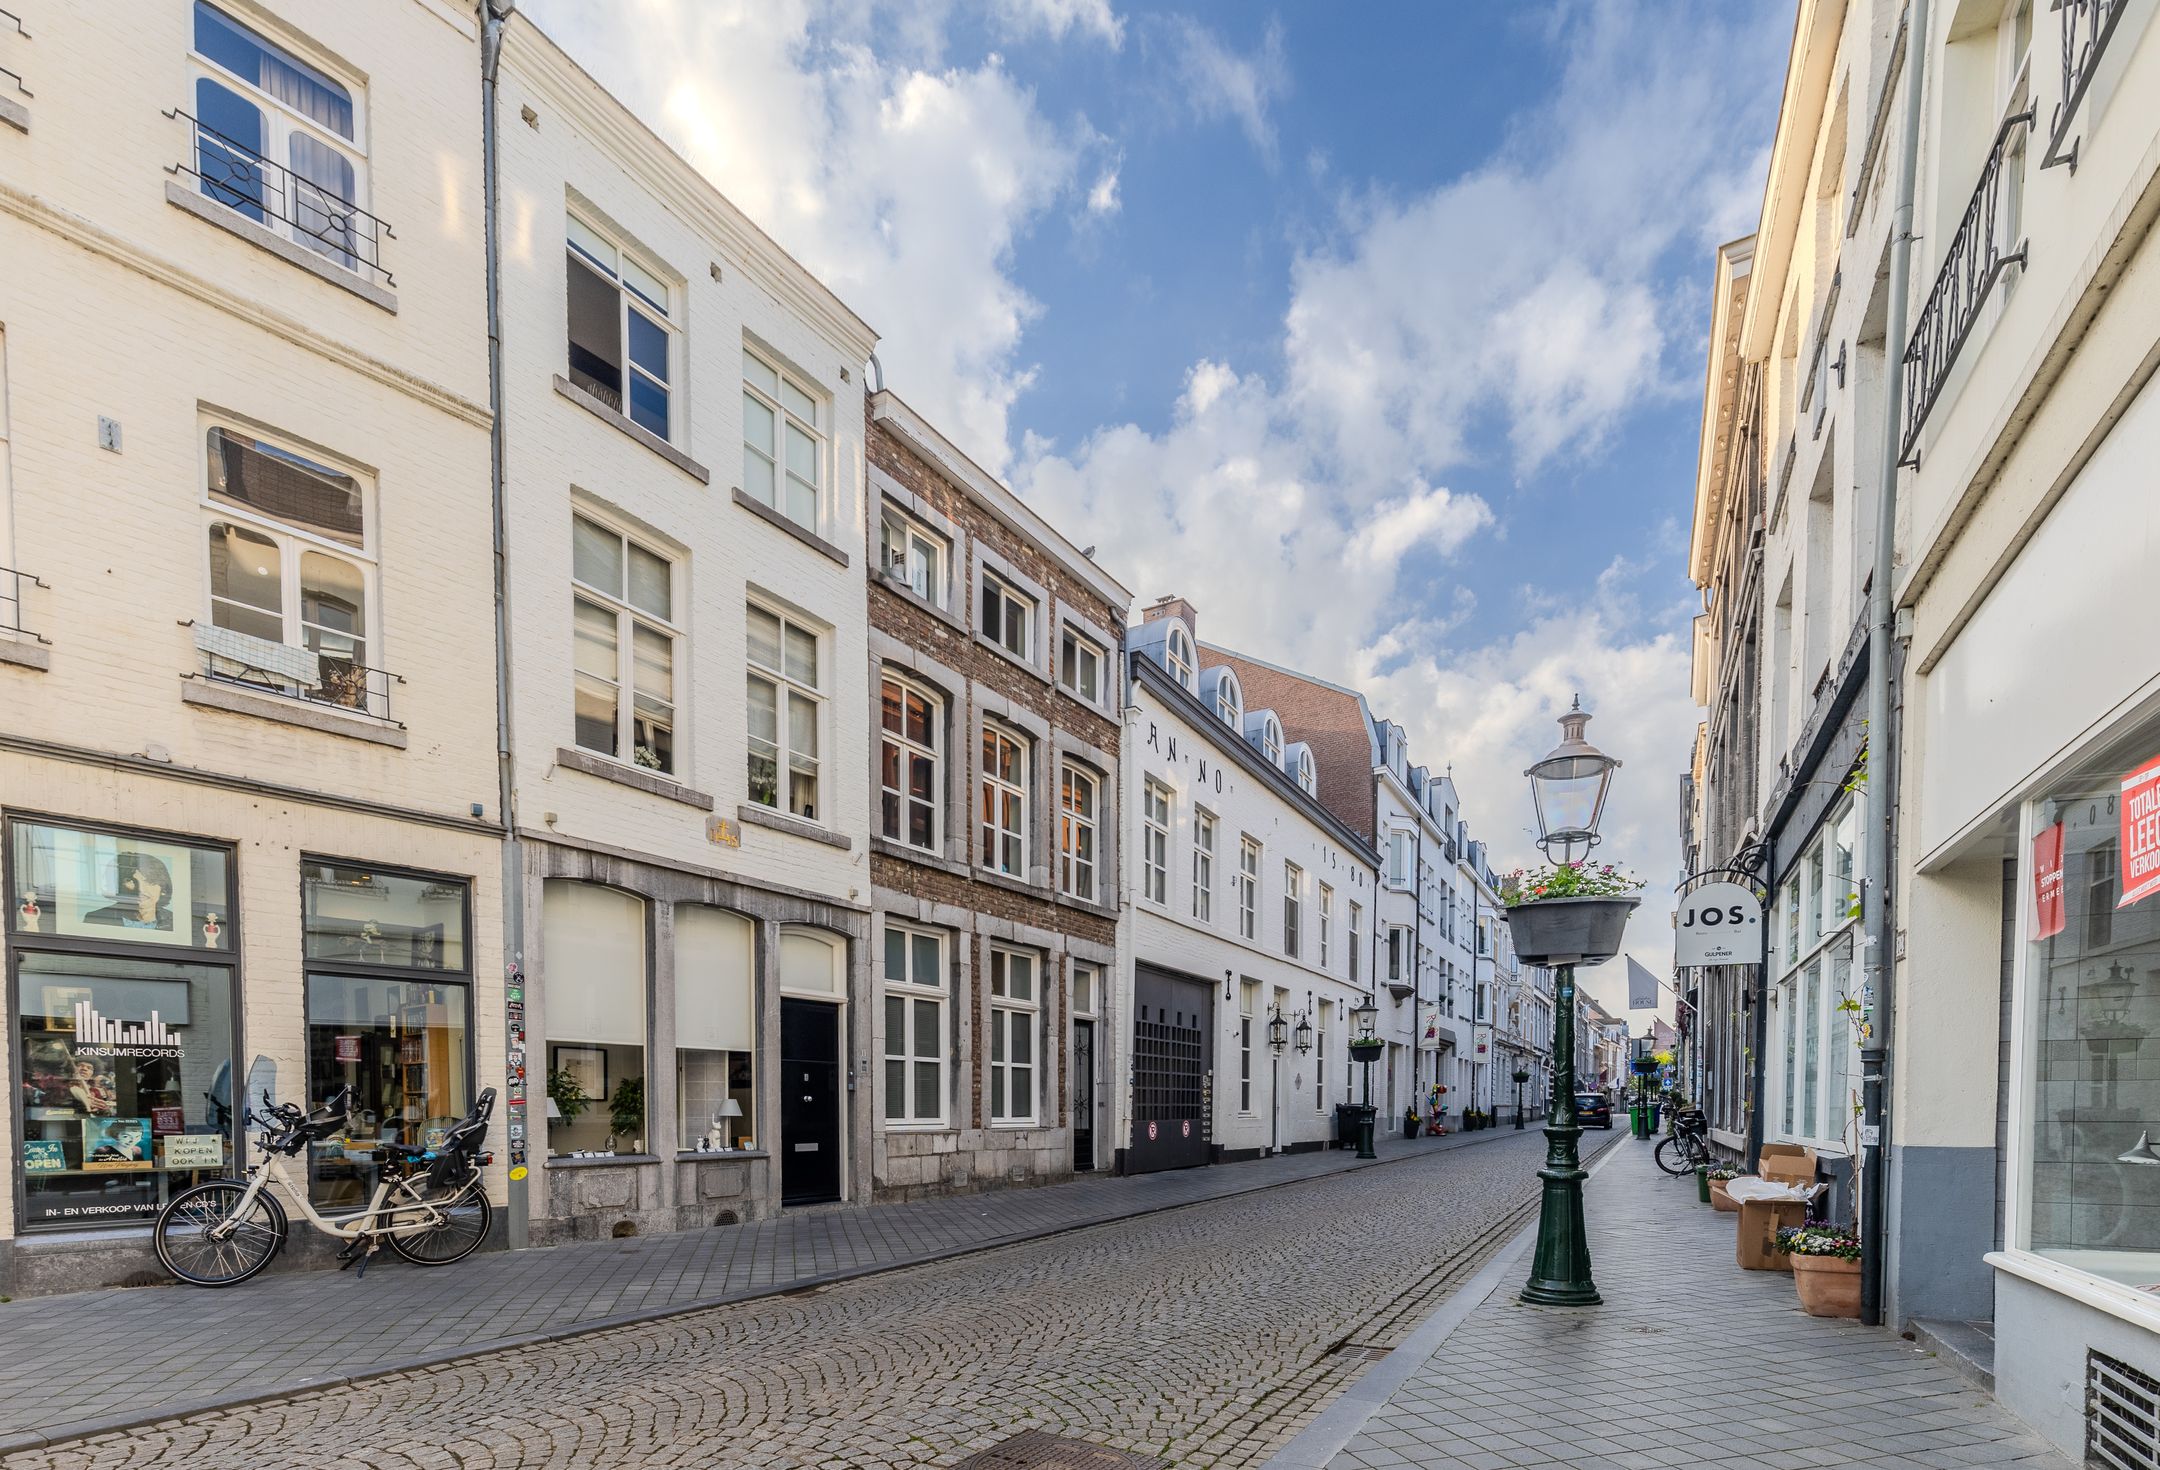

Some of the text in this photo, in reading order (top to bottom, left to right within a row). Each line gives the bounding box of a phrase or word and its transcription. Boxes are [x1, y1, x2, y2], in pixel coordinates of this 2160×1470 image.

[1704, 950, 1733, 958] GULPENER
[174, 1147, 213, 1155] KOPEN
[24, 1158, 62, 1169] OPEN
[64, 1207, 79, 1216] EN
[81, 1204, 131, 1215] VERKOOP
[133, 1203, 154, 1212] VAN
